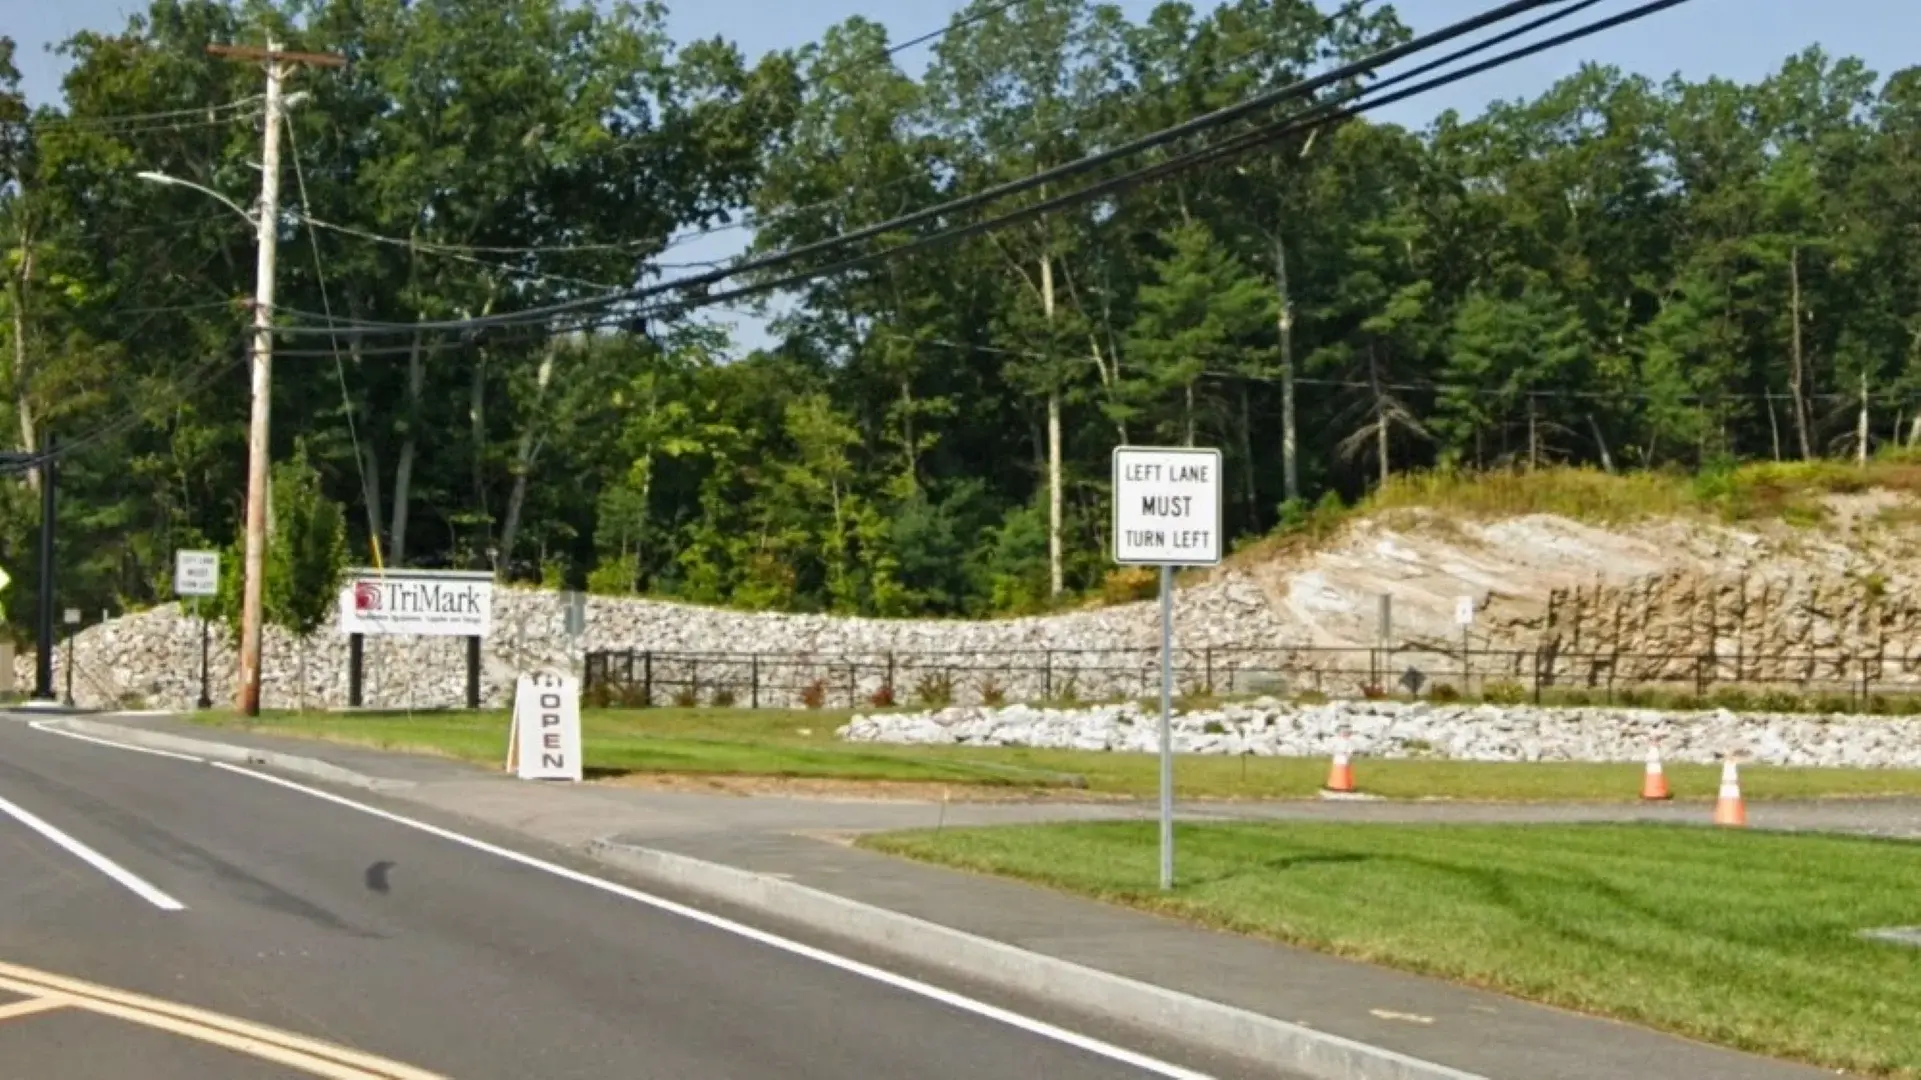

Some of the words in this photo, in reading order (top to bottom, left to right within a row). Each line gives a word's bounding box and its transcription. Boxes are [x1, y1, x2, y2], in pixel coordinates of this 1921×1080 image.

[1125, 464, 1162, 481] LEFT
[1169, 464, 1209, 483] LANE
[1142, 495, 1192, 517] MUST
[1125, 530, 1165, 547] TURN
[1172, 530, 1209, 548] LEFT
[387, 583, 481, 613] TriMark
[540, 693, 564, 769] OPEN
